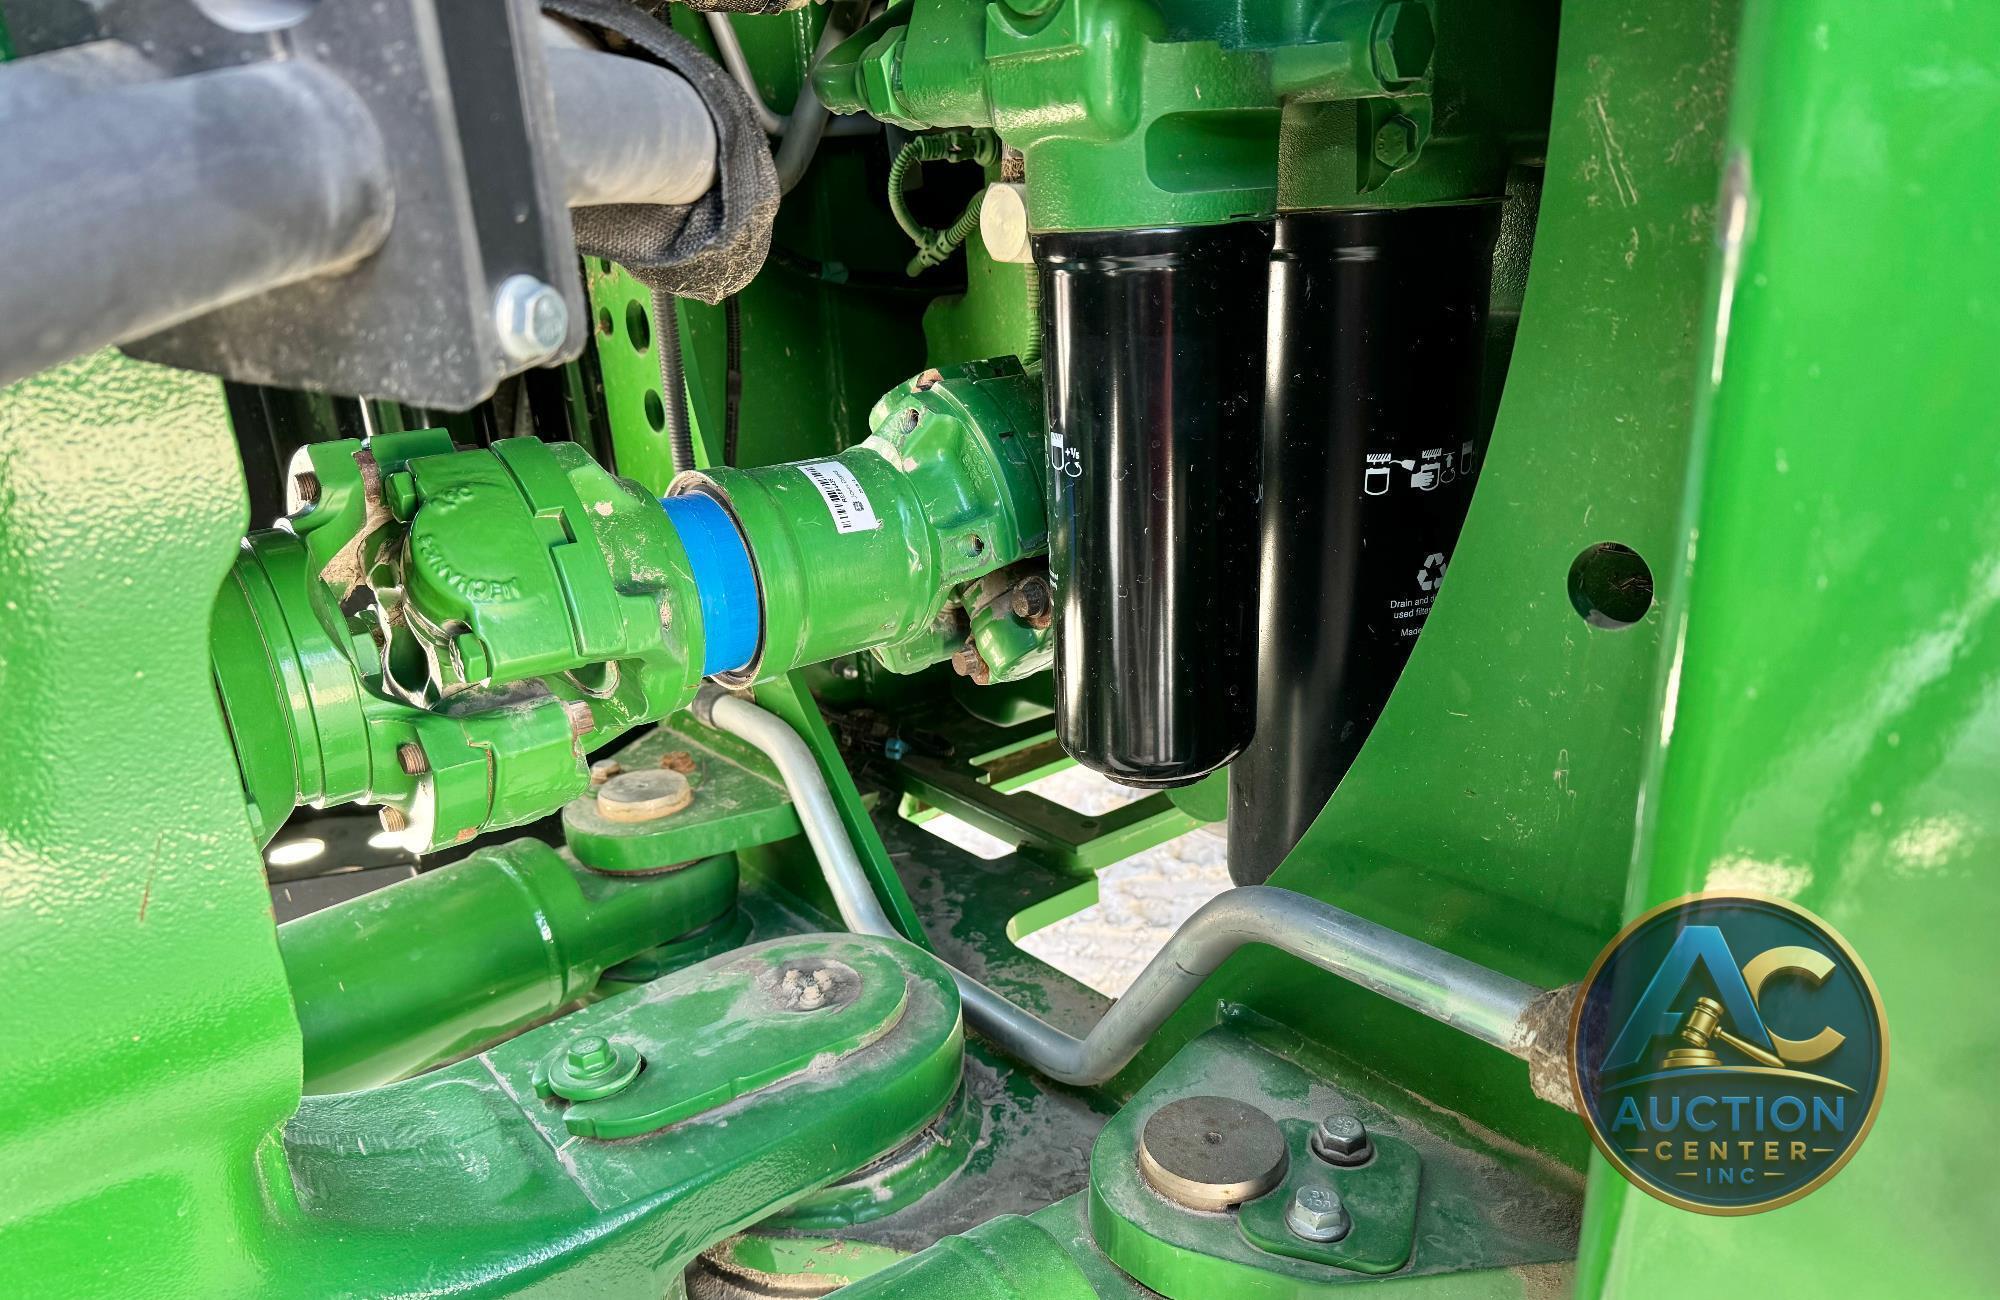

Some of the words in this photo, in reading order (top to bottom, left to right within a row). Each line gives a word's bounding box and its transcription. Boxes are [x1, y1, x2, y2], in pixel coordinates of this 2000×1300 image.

[1390, 598, 1413, 609] Drain
[1414, 595, 1429, 606] and
[1393, 608, 1414, 619] used
